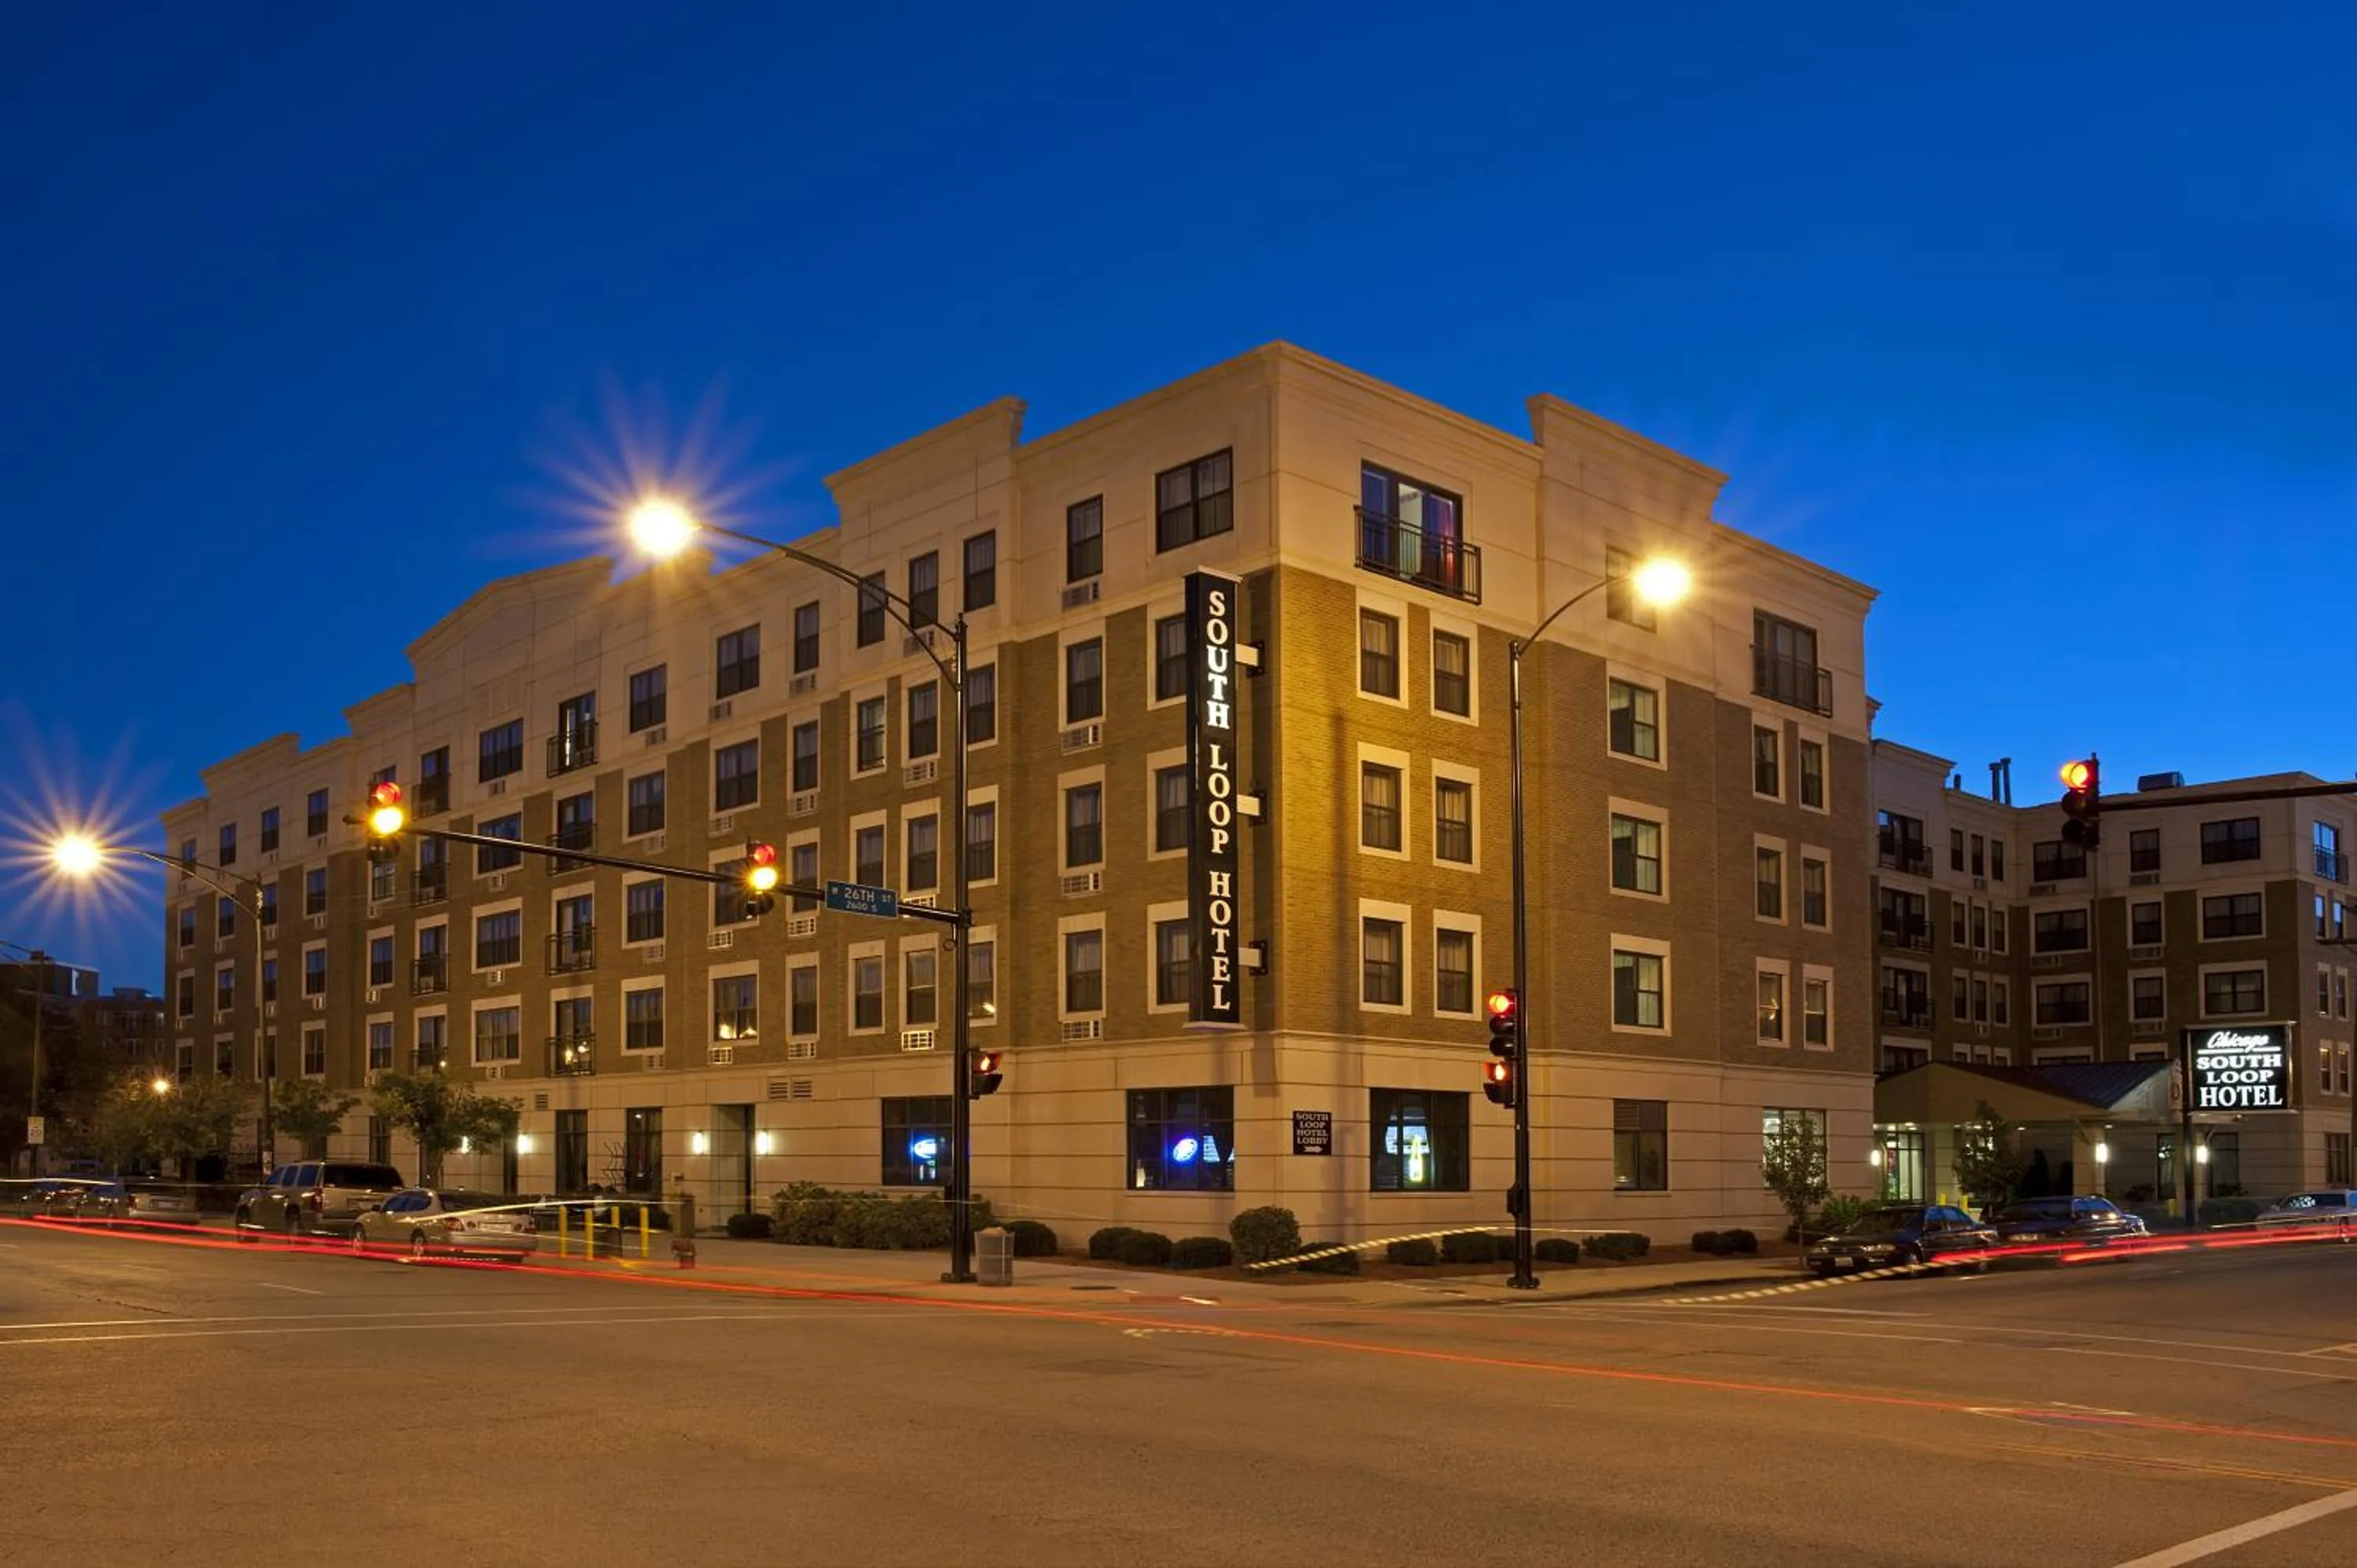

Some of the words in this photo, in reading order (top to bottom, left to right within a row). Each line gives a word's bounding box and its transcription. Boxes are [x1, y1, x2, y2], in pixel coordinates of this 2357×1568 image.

[1206, 591, 1230, 729] SOUTH
[1208, 744, 1230, 854] LOOP
[845, 887, 874, 903] 26TH
[882, 893, 892, 903] ST
[1209, 871, 1231, 1010] HOTEL
[2207, 1031, 2270, 1053] Chicago
[2196, 1053, 2282, 1070] SOUTH
[2206, 1069, 2274, 1084] LOOP
[2200, 1085, 2282, 1107] HOTEL
